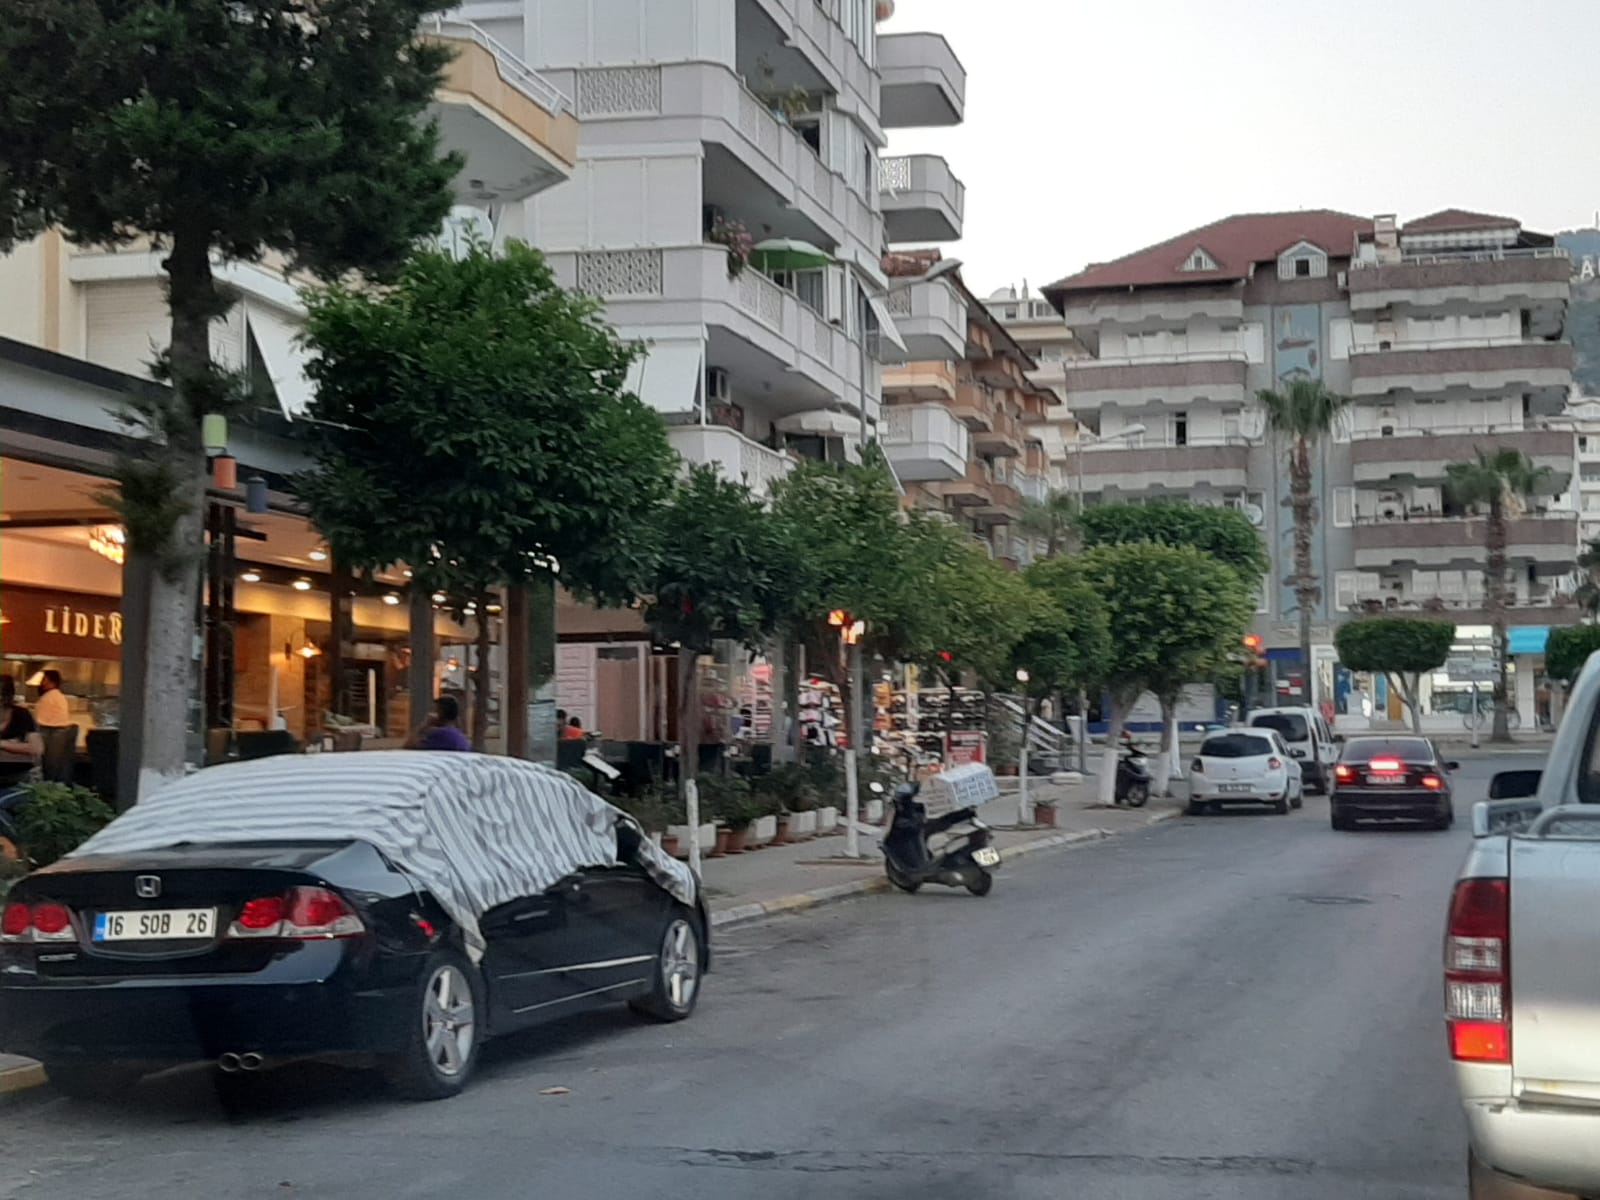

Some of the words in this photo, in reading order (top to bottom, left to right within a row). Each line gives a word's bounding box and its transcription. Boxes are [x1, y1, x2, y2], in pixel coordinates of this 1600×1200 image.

[108, 915, 125, 936] 16
[139, 913, 171, 935] SOB
[186, 912, 208, 934] 26
